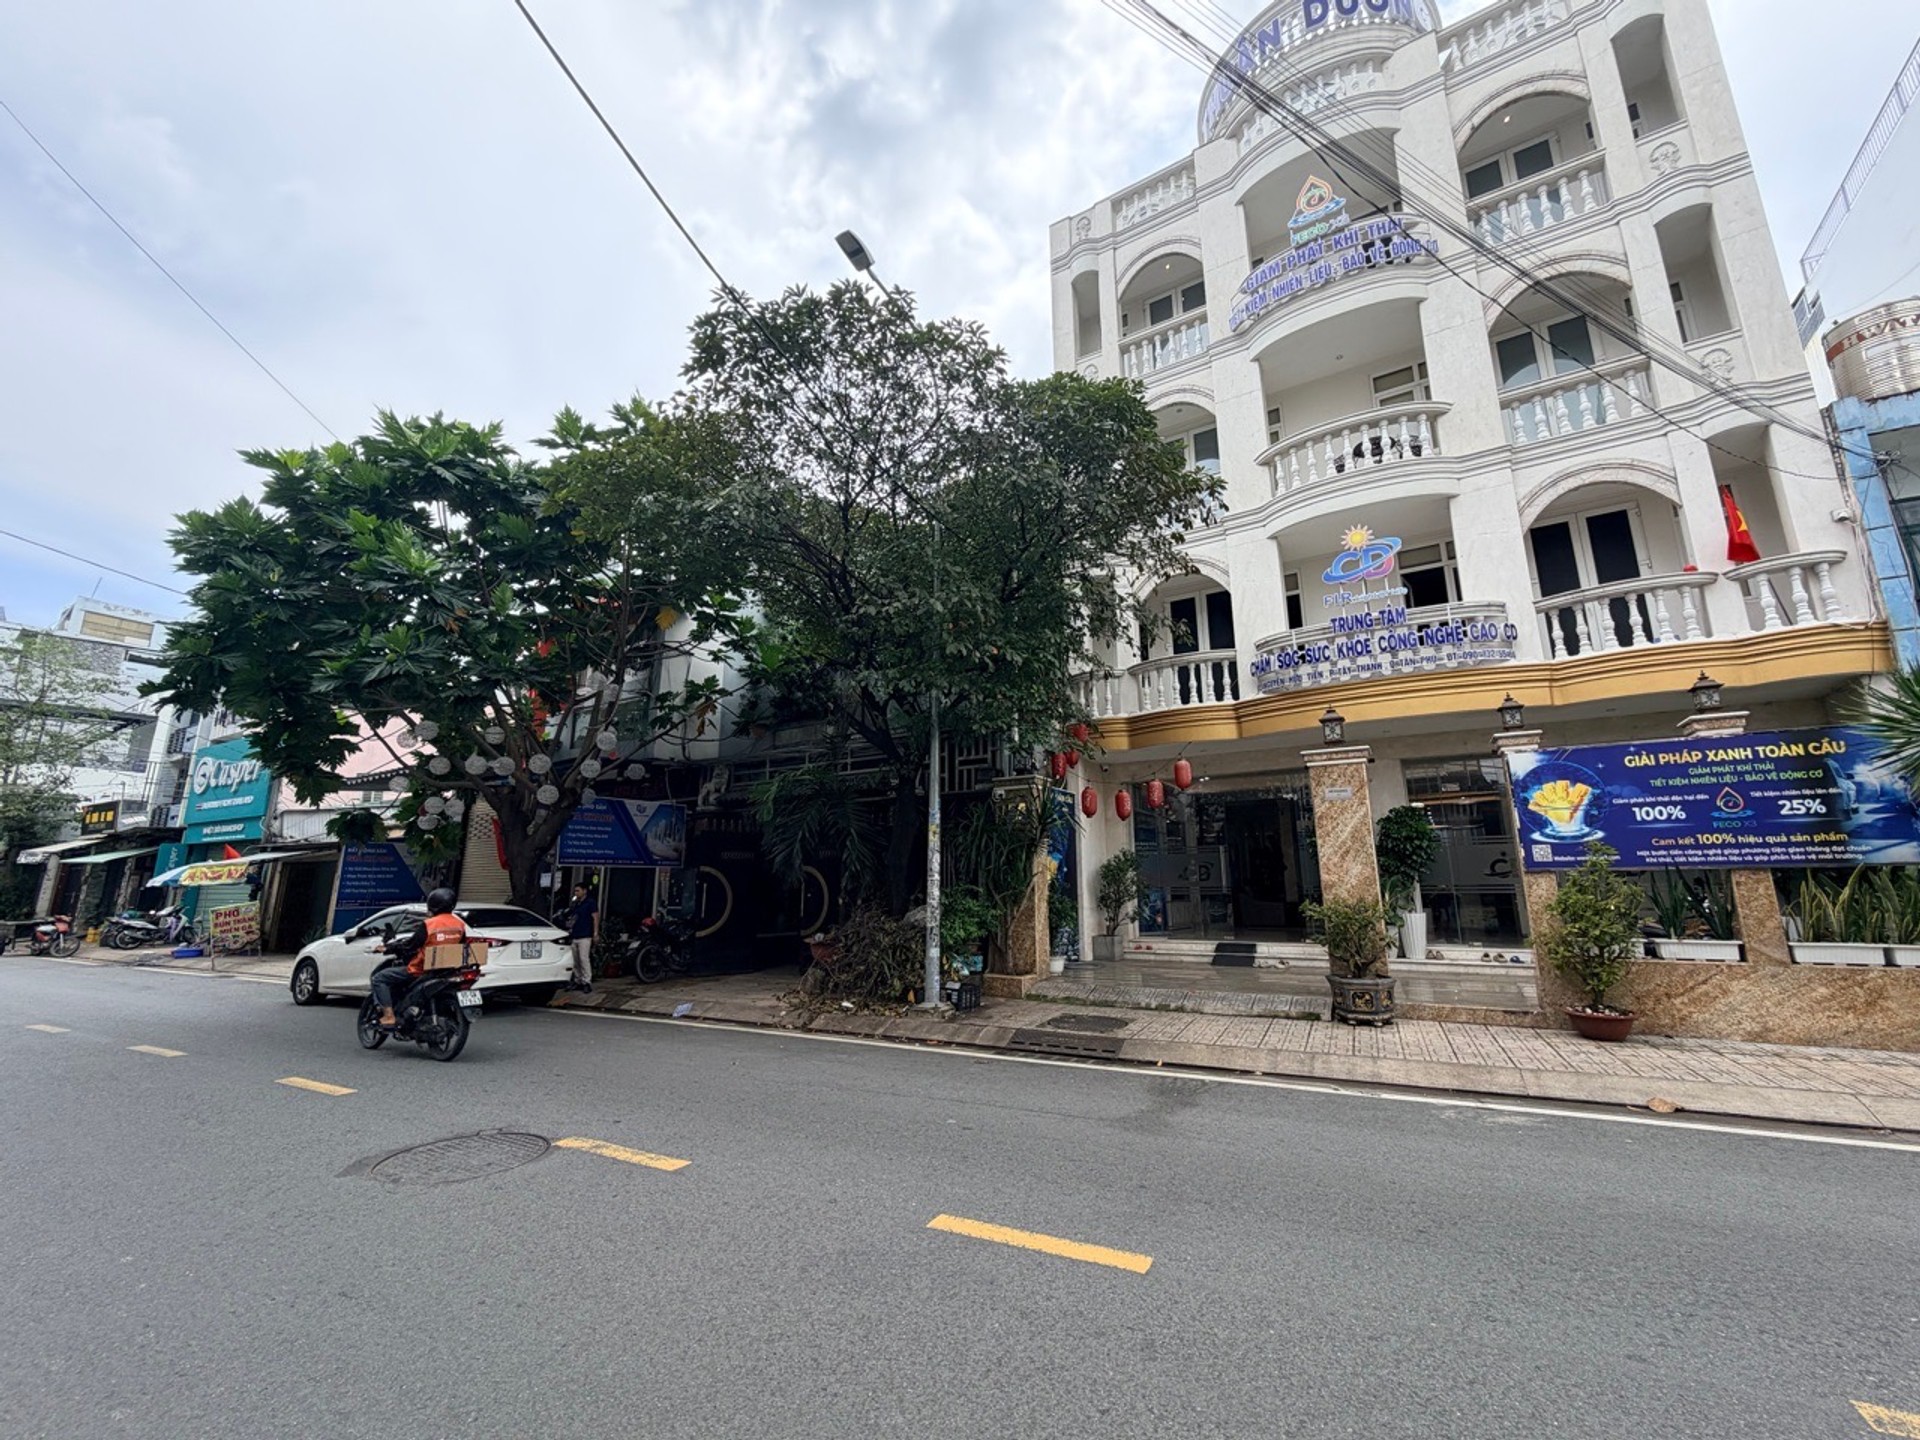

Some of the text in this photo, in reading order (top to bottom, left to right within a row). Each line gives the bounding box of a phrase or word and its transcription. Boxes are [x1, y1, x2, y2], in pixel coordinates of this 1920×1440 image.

[1330, 603, 1407, 633] TRUNG TÂM
[1378, 629, 1418, 653] CÔNG
[1423, 619, 1464, 647] NGHỆ
[1469, 622, 1499, 641] CAO
[1503, 622, 1518, 641] CD
[1624, 737, 1847, 768] GIẢI PHÁP XANH TOÀN CẦU
[1632, 805, 1687, 821] 100%
[1777, 798, 1827, 815] 25%
[1651, 838, 1676, 846] Cam
[1677, 835, 1695, 845] kết
[1696, 832, 1736, 845] 100%
[1737, 834, 1763, 845] hiệu
[1765, 832, 1788, 843] quả
